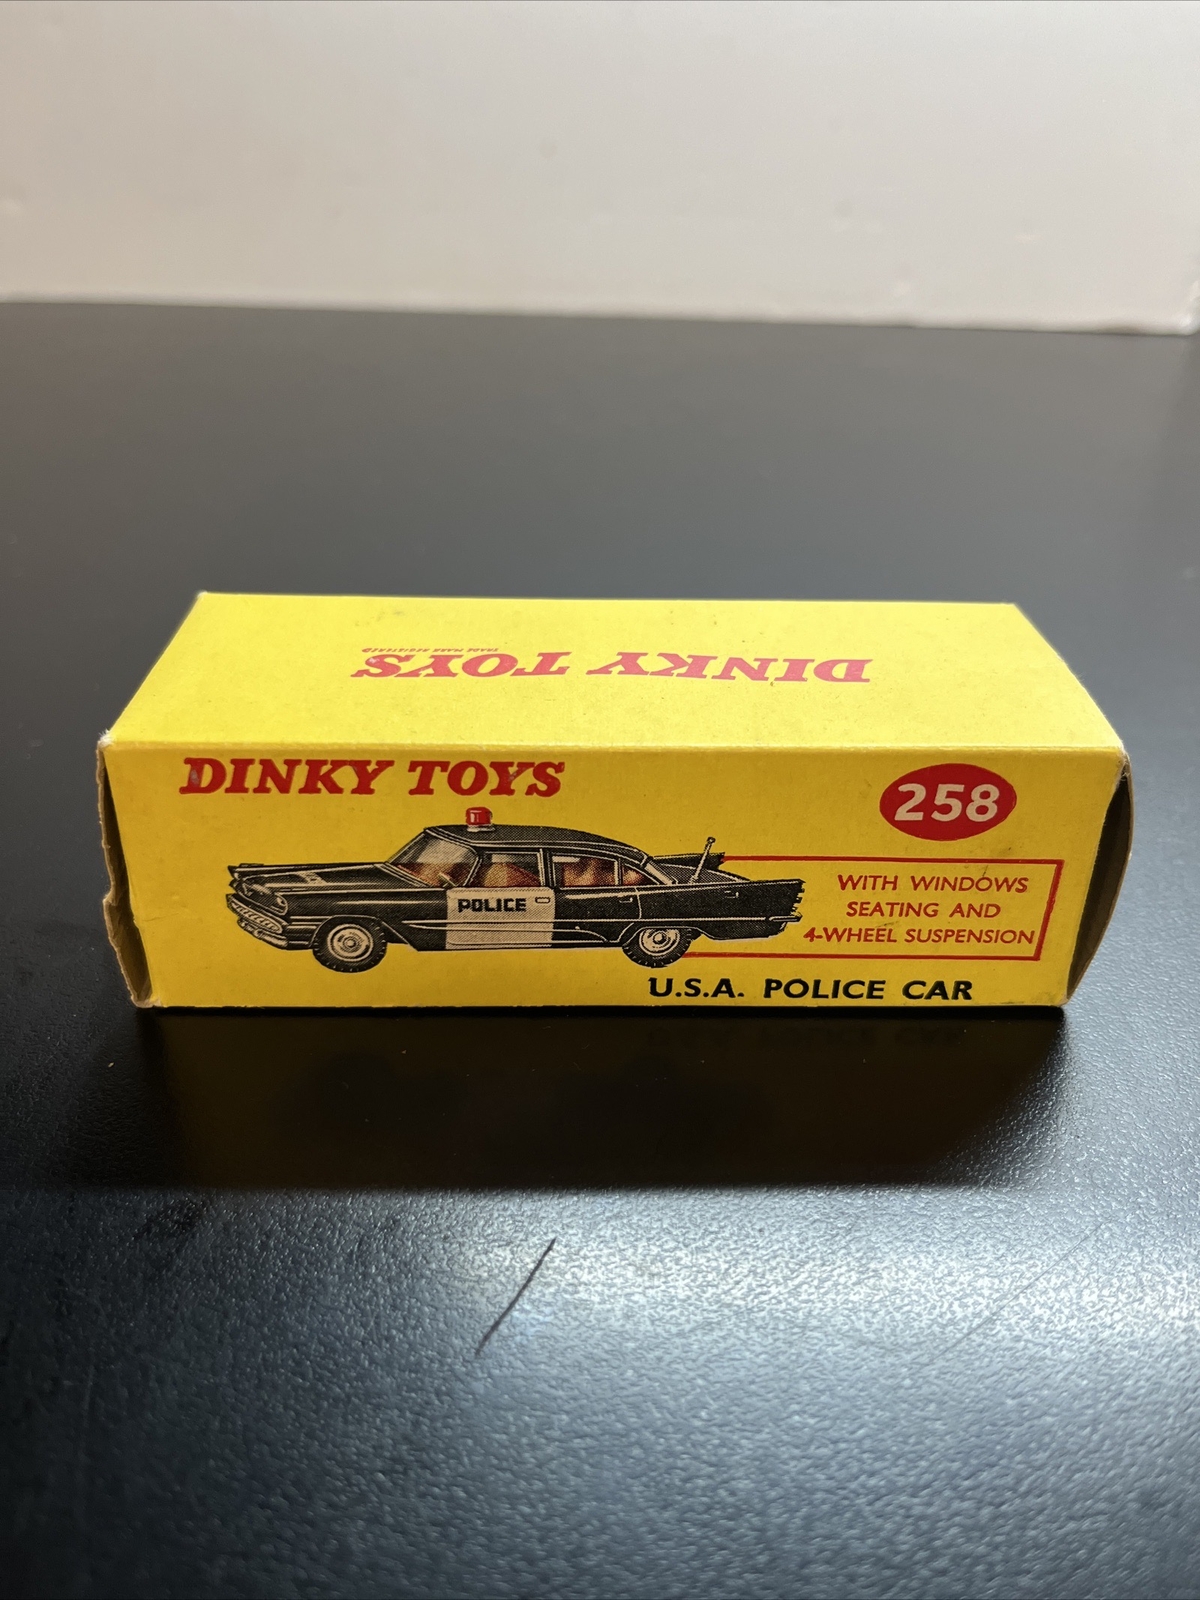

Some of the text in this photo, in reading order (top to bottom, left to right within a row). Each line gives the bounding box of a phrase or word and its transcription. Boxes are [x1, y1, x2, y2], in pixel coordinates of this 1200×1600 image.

[350, 651, 874, 683] DINKY TOYS
[179, 757, 566, 798] DINKY TOYS
[894, 782, 999, 822] 258
[837, 874, 1029, 893] WITH WINDOWS
[457, 897, 527, 913] POLICE
[846, 901, 1001, 919] SEATING AND
[803, 926, 1035, 945] 4-WHEEL SUSPENSION
[648, 977, 973, 1001] U.S.A. POLICE CAR
